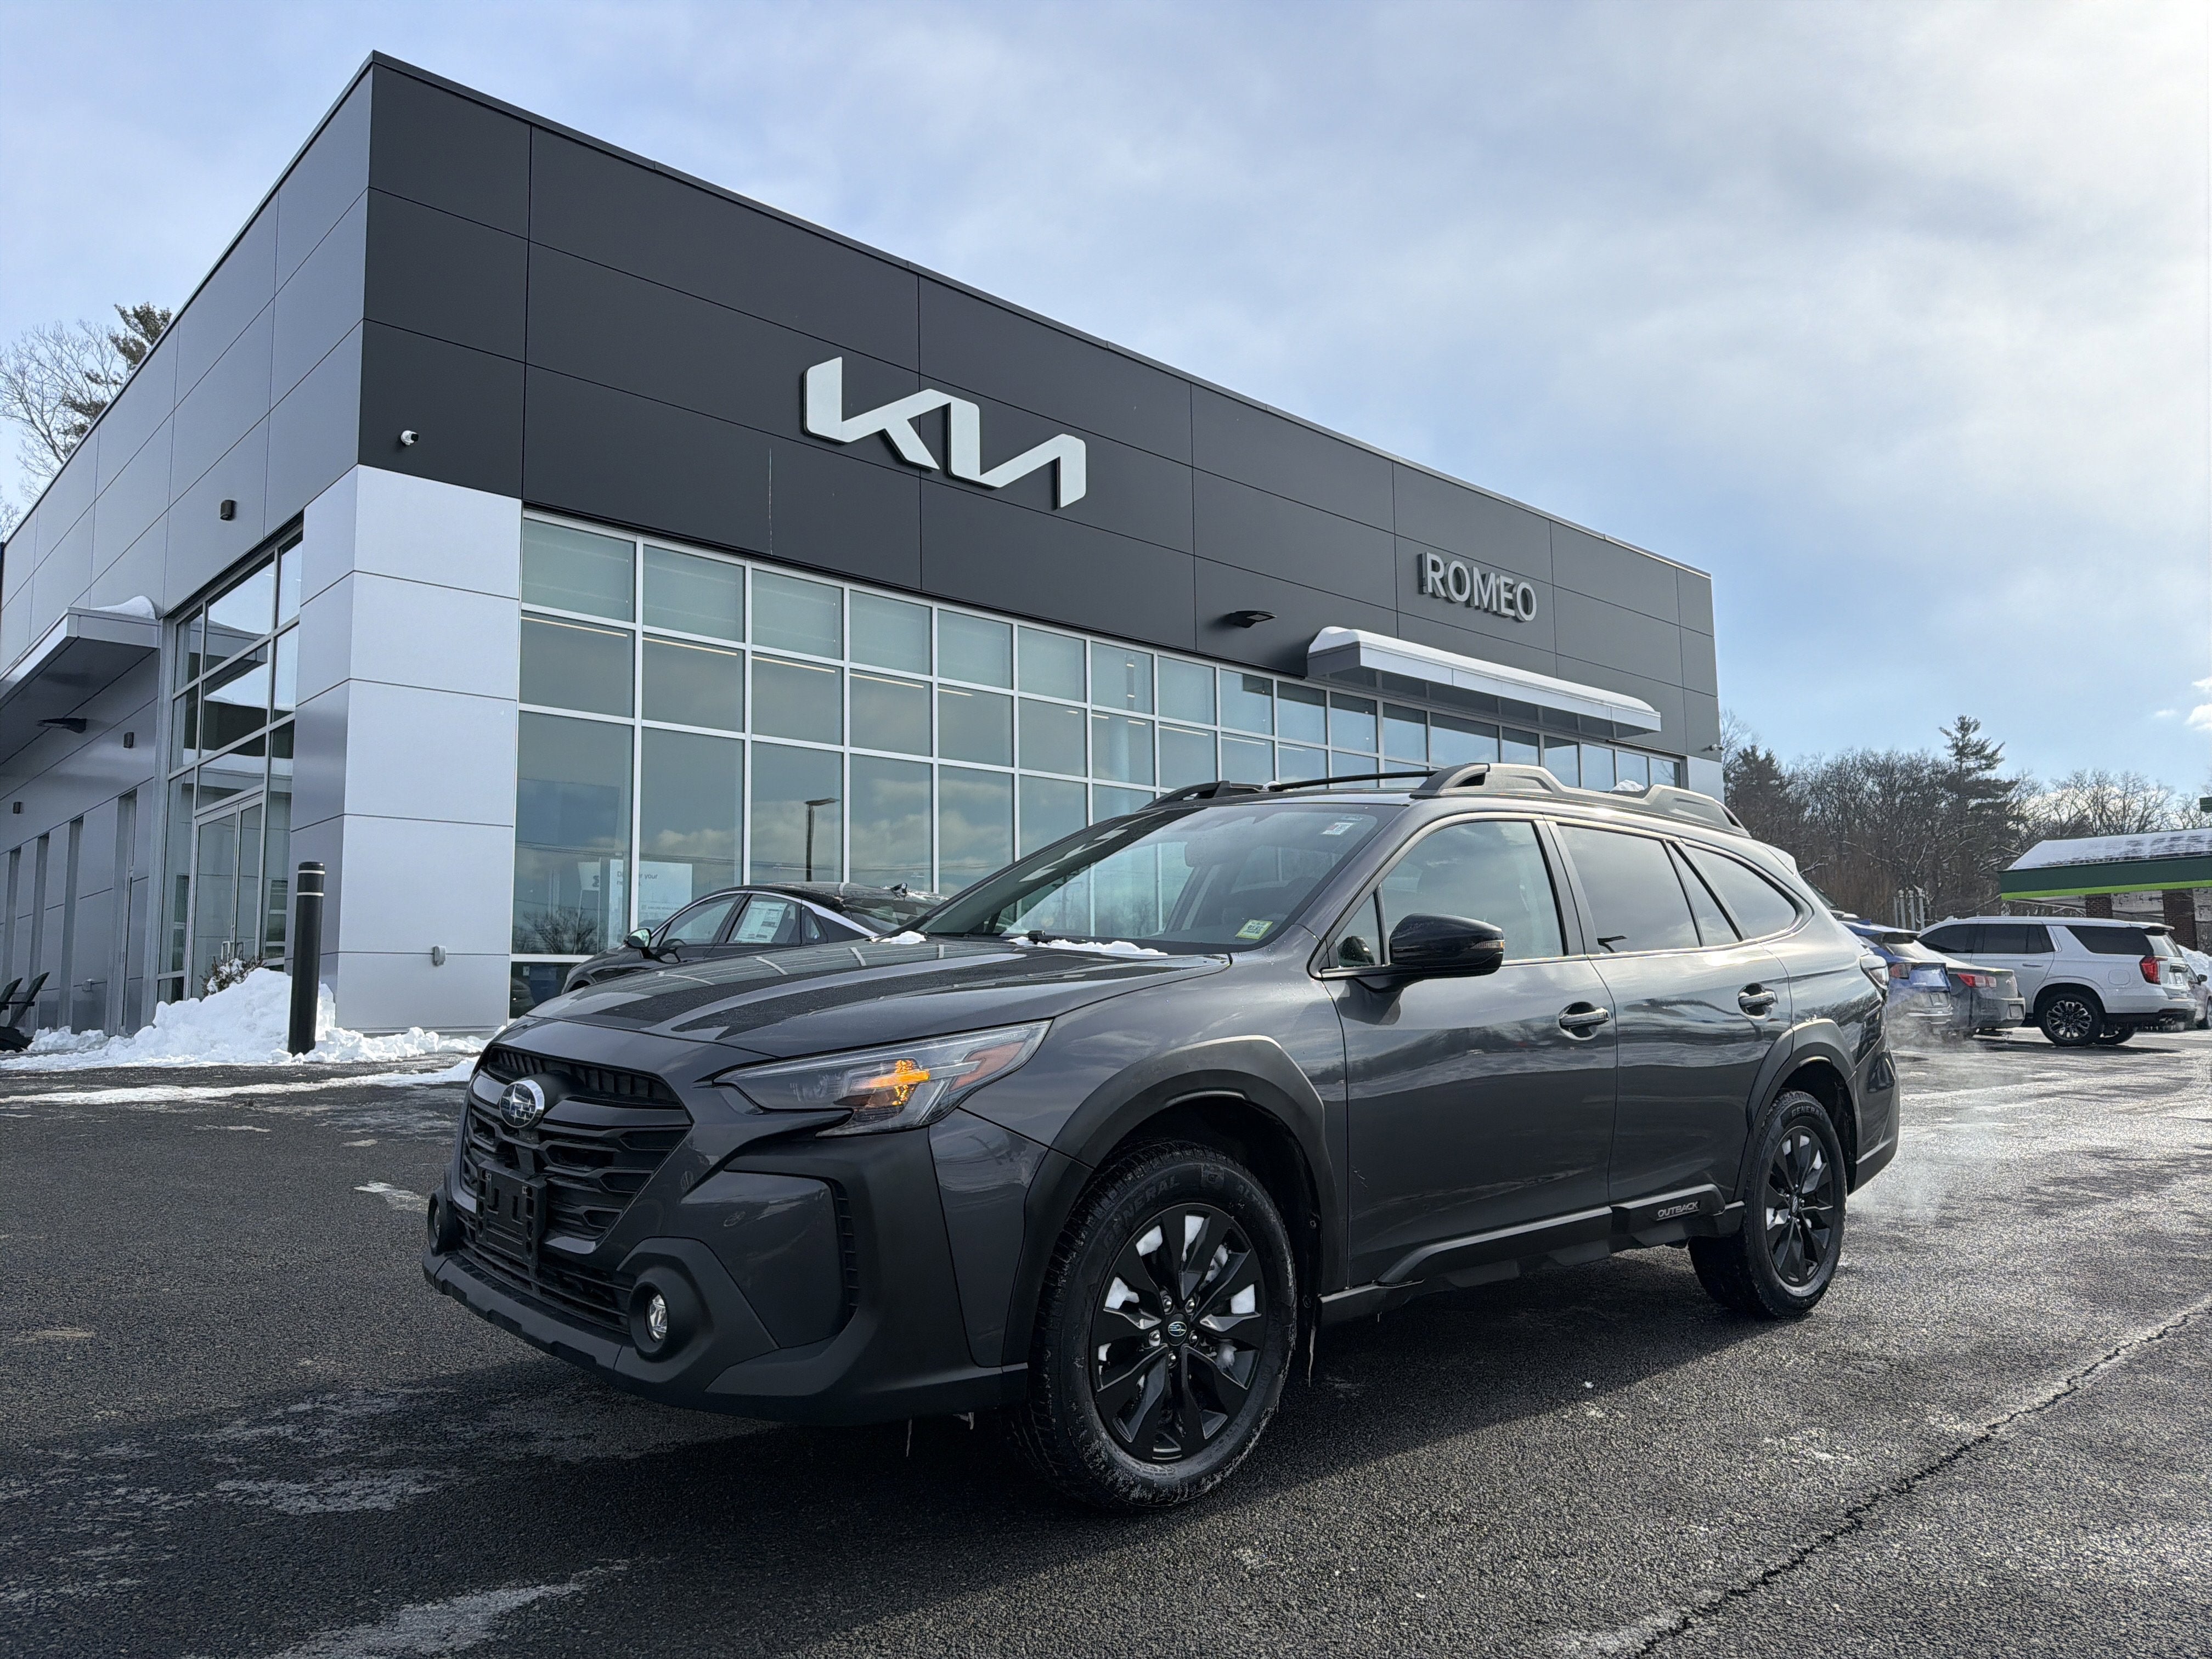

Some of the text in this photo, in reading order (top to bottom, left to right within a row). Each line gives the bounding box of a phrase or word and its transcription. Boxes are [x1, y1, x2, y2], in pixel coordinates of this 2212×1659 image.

[1423, 551, 1536, 621] ROMEO
[1791, 1105, 1824, 1120] GENERAL
[1657, 1201, 1699, 1217] OUTBACK
